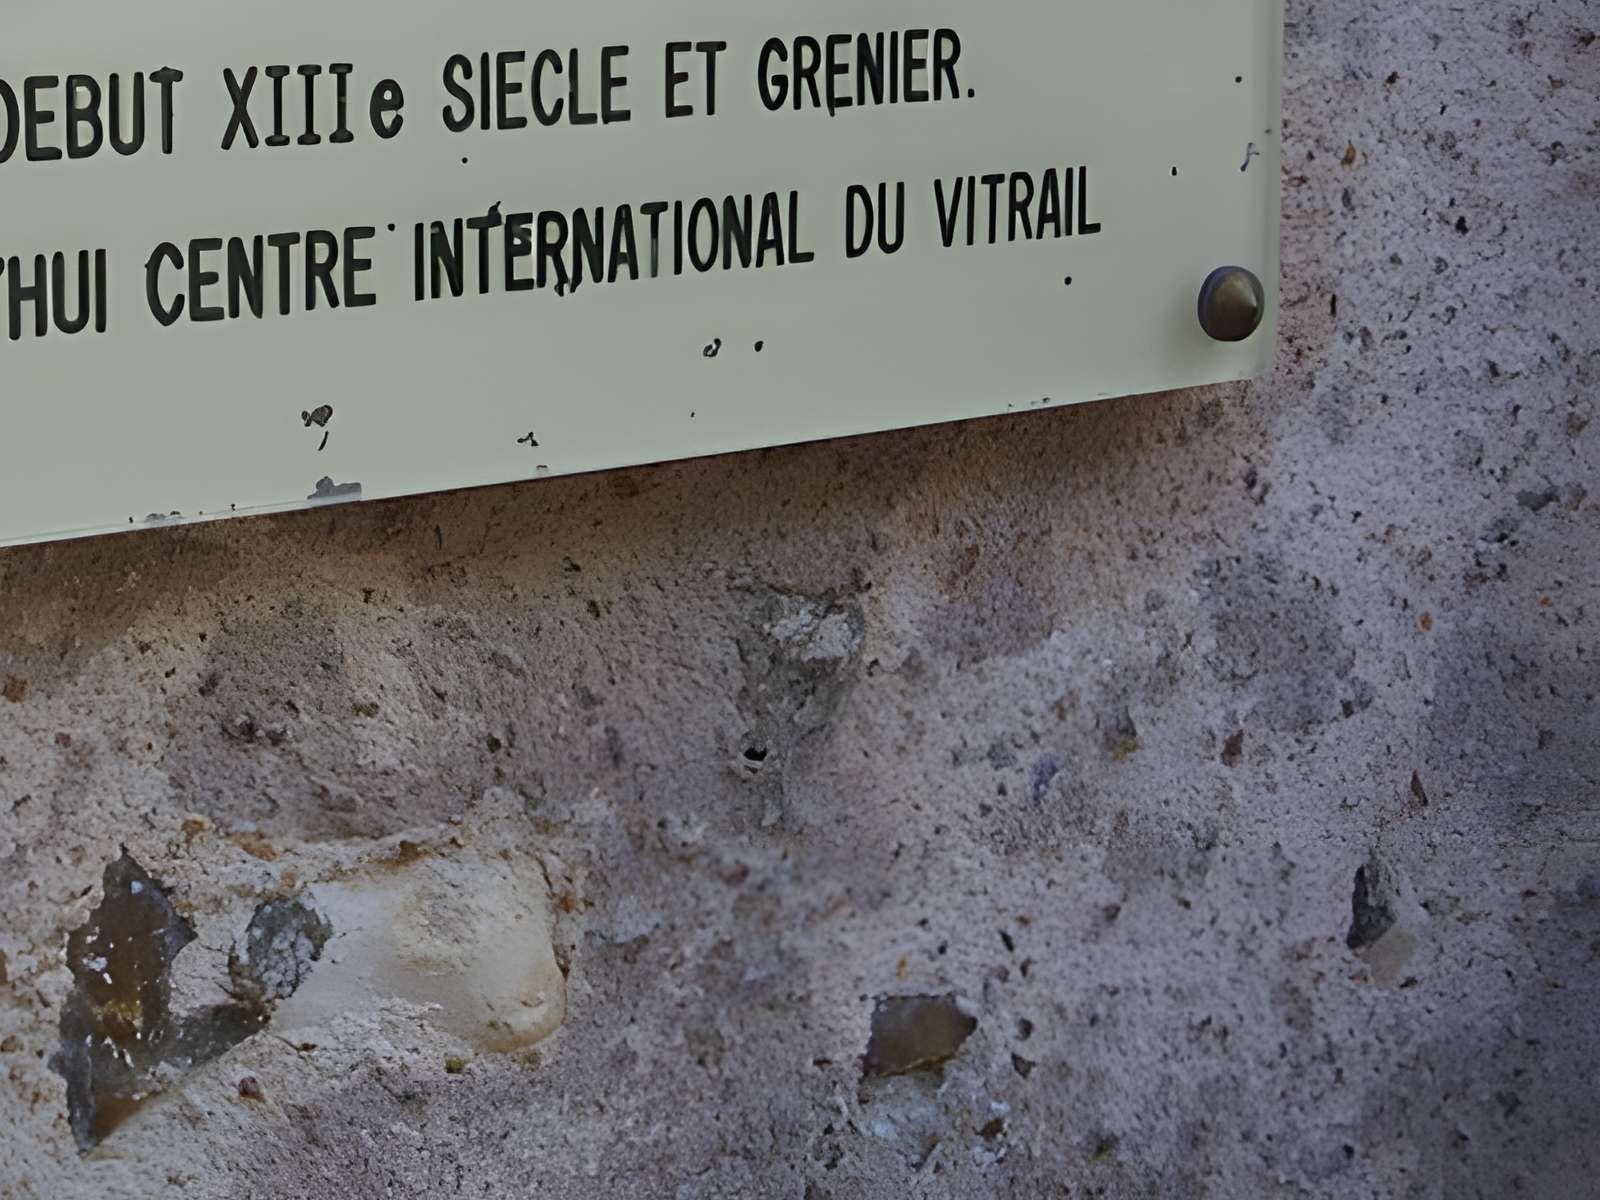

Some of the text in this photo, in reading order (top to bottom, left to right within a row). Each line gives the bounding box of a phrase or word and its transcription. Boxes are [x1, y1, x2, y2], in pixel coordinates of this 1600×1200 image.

[443, 45, 631, 132] SIECLE
[665, 41, 726, 118] ET
[758, 29, 974, 117] GRENIER.
[147, 227, 376, 326] CENTRE
[415, 191, 814, 301] INTERNATIONAL
[846, 182, 904, 258] DU
[934, 166, 1101, 247] VITRAIL
